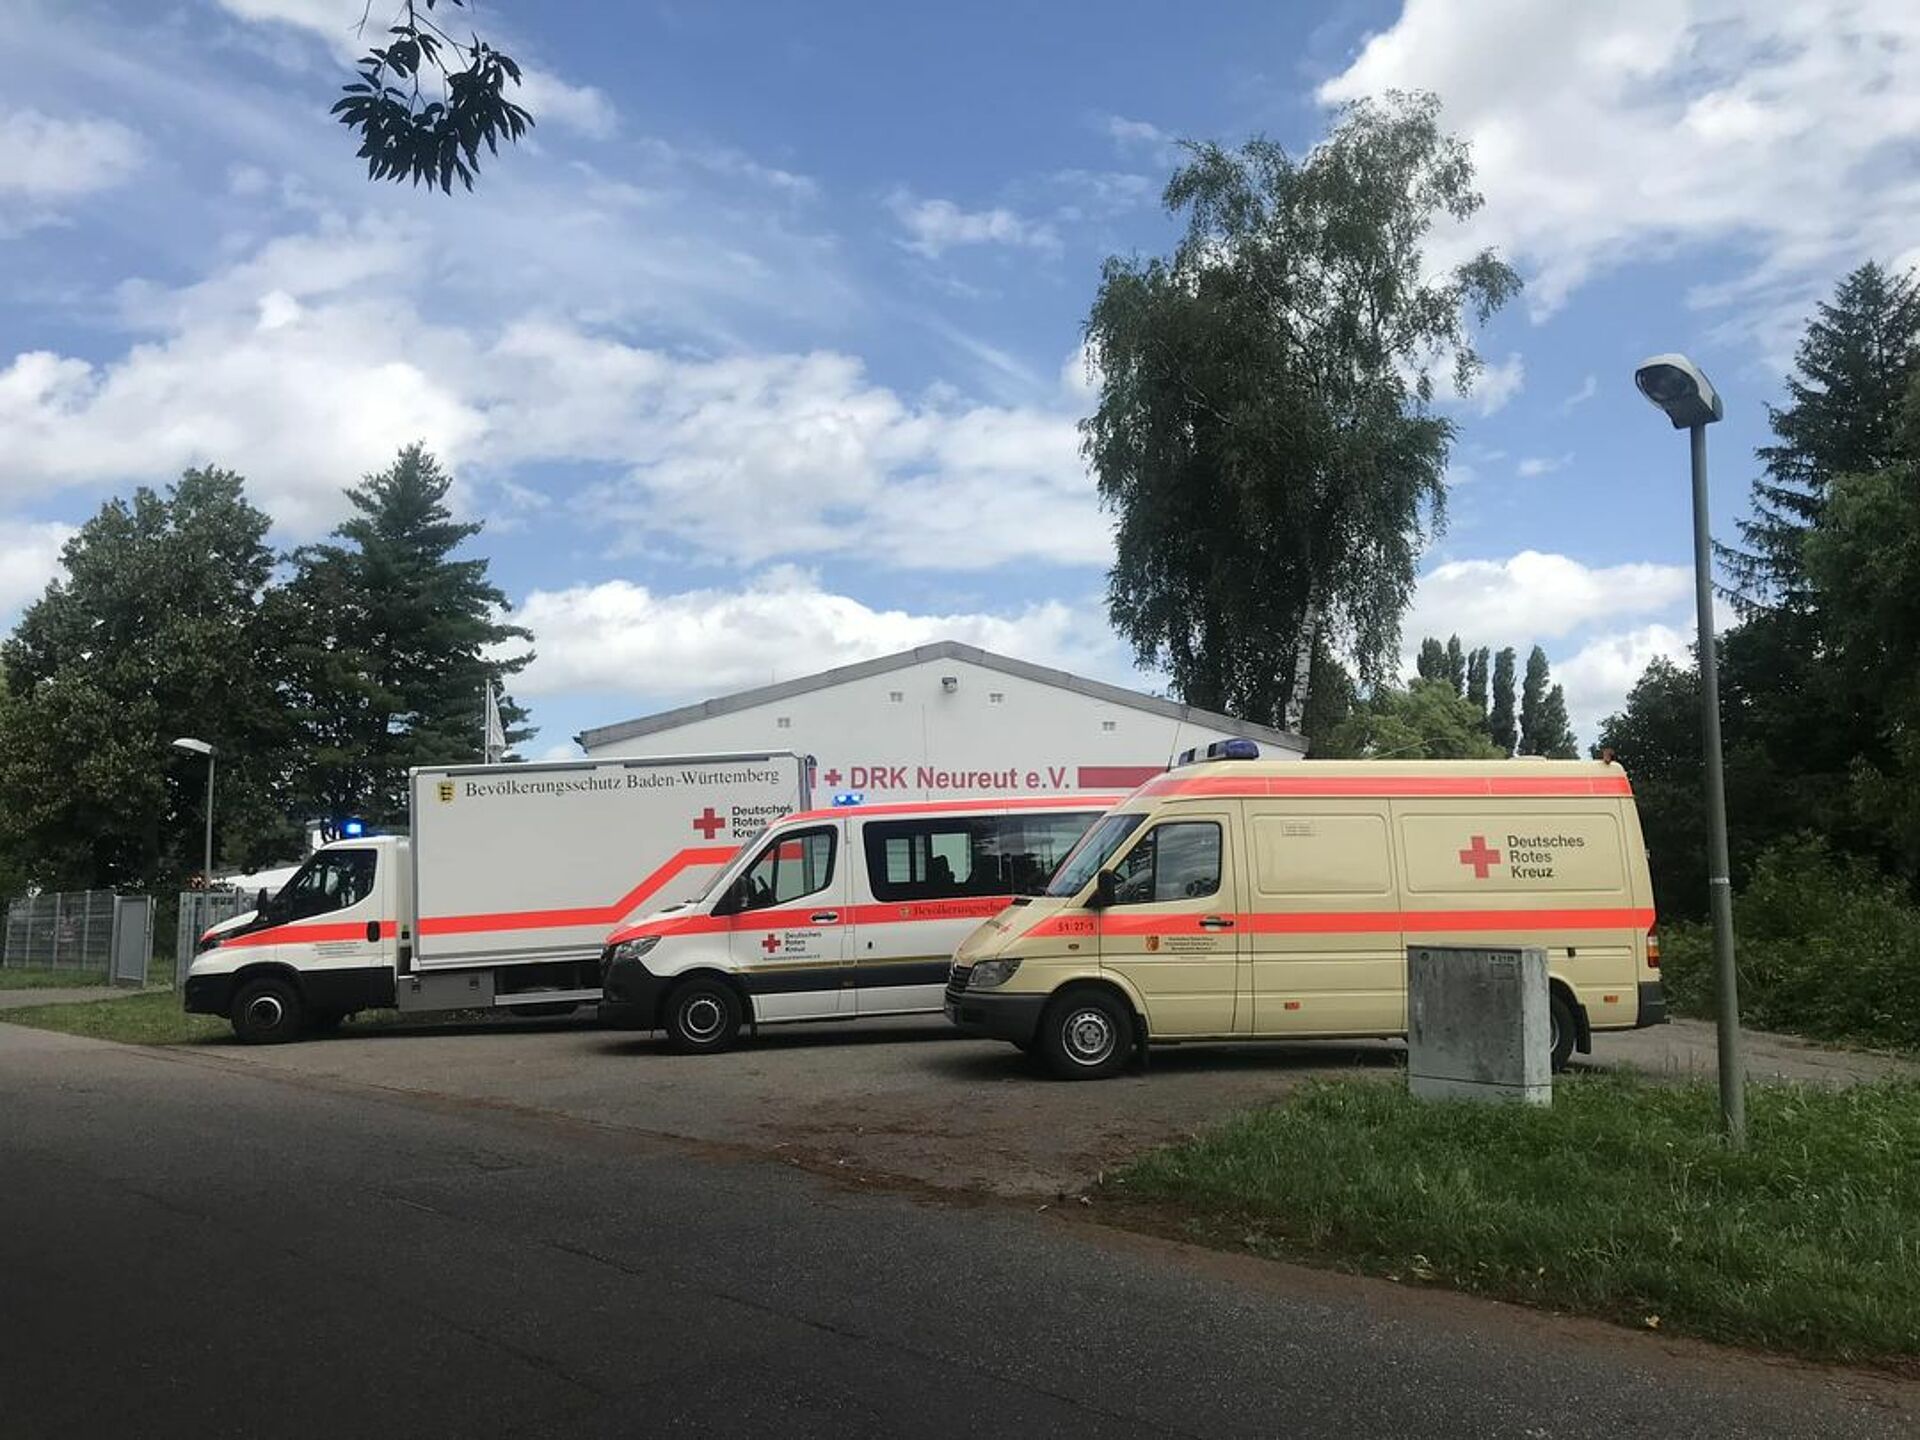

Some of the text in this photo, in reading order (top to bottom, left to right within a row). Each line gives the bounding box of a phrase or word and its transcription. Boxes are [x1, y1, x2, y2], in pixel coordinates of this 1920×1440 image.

[466, 768, 780, 797] Bevölkerungsschutz Baden-Württemberg
[851, 767, 1070, 789] DRK Neureut e.V.
[732, 804, 793, 817] Deutsches
[732, 818, 767, 828] Rotes
[1507, 835, 1585, 848] Deutsches
[1509, 850, 1553, 863] Rotes
[1511, 865, 1555, 879] Kreuz
